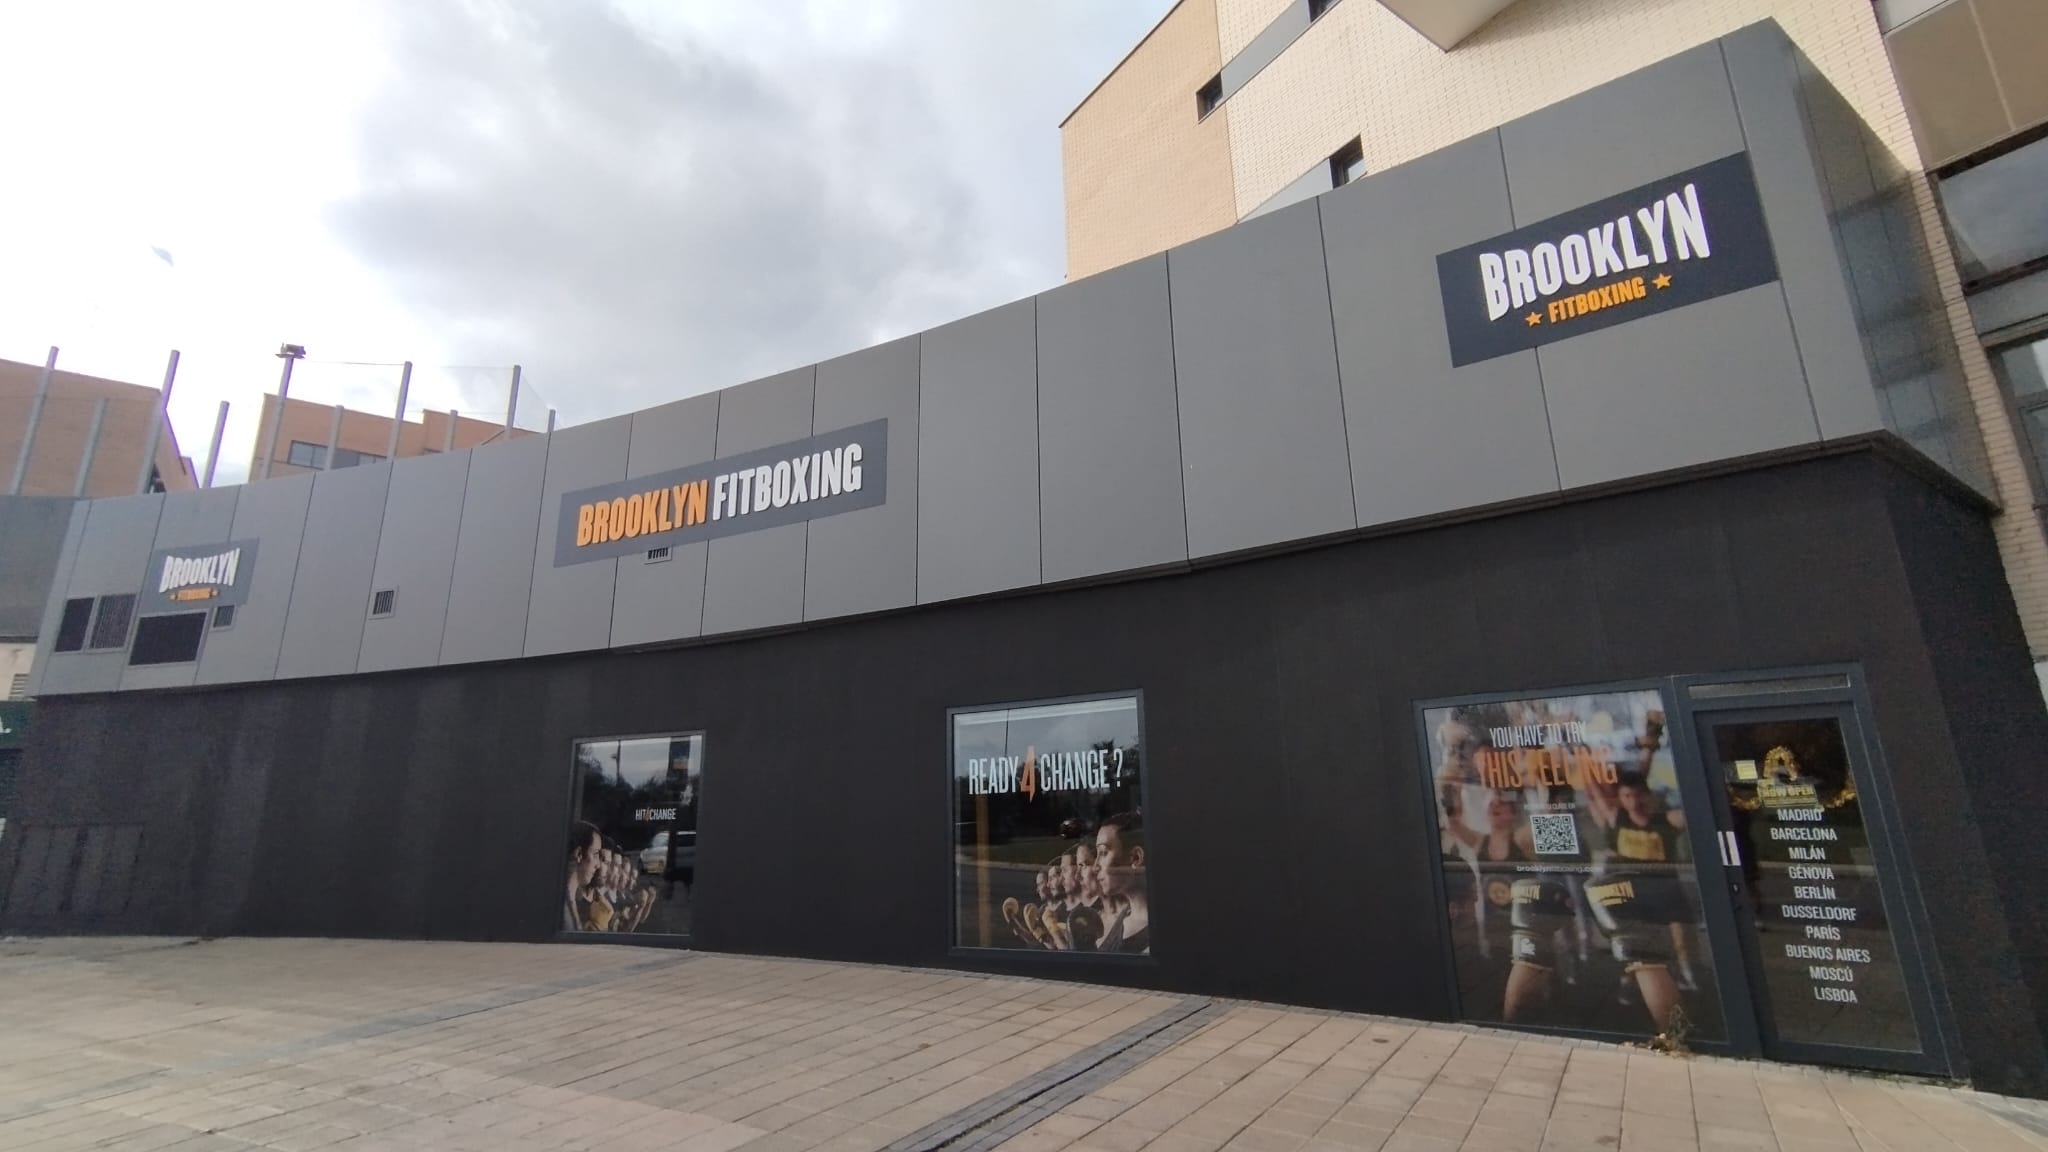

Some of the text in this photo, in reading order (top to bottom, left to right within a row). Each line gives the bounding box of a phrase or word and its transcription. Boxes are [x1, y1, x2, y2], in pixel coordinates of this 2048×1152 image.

[1479, 183, 1711, 321] BROOKLYN
[1548, 276, 1646, 323] FITBOXING
[576, 443, 863, 547] BROOKLYN FITBOXING
[159, 547, 240, 593] BROOKLYN
[1489, 721, 1586, 748] YOU HAVE TO TRY
[968, 745, 1124, 803] READY 4 CHANGE ?
[1474, 746, 1618, 789] THIS EELING
[1777, 808, 1823, 821] MADRID
[1770, 828, 1838, 841] BARCELONA
[1788, 845, 1826, 860] MILÁN
[1794, 884, 1836, 900] BERLÍN
[1781, 904, 1857, 921] DUSSELDORF
[1805, 924, 1841, 940] PARÍS
[1785, 944, 1871, 963] BUENOS AIRES
[1809, 966, 1854, 982] MOSCÚ
[1814, 986, 1858, 1003] LISBOA
